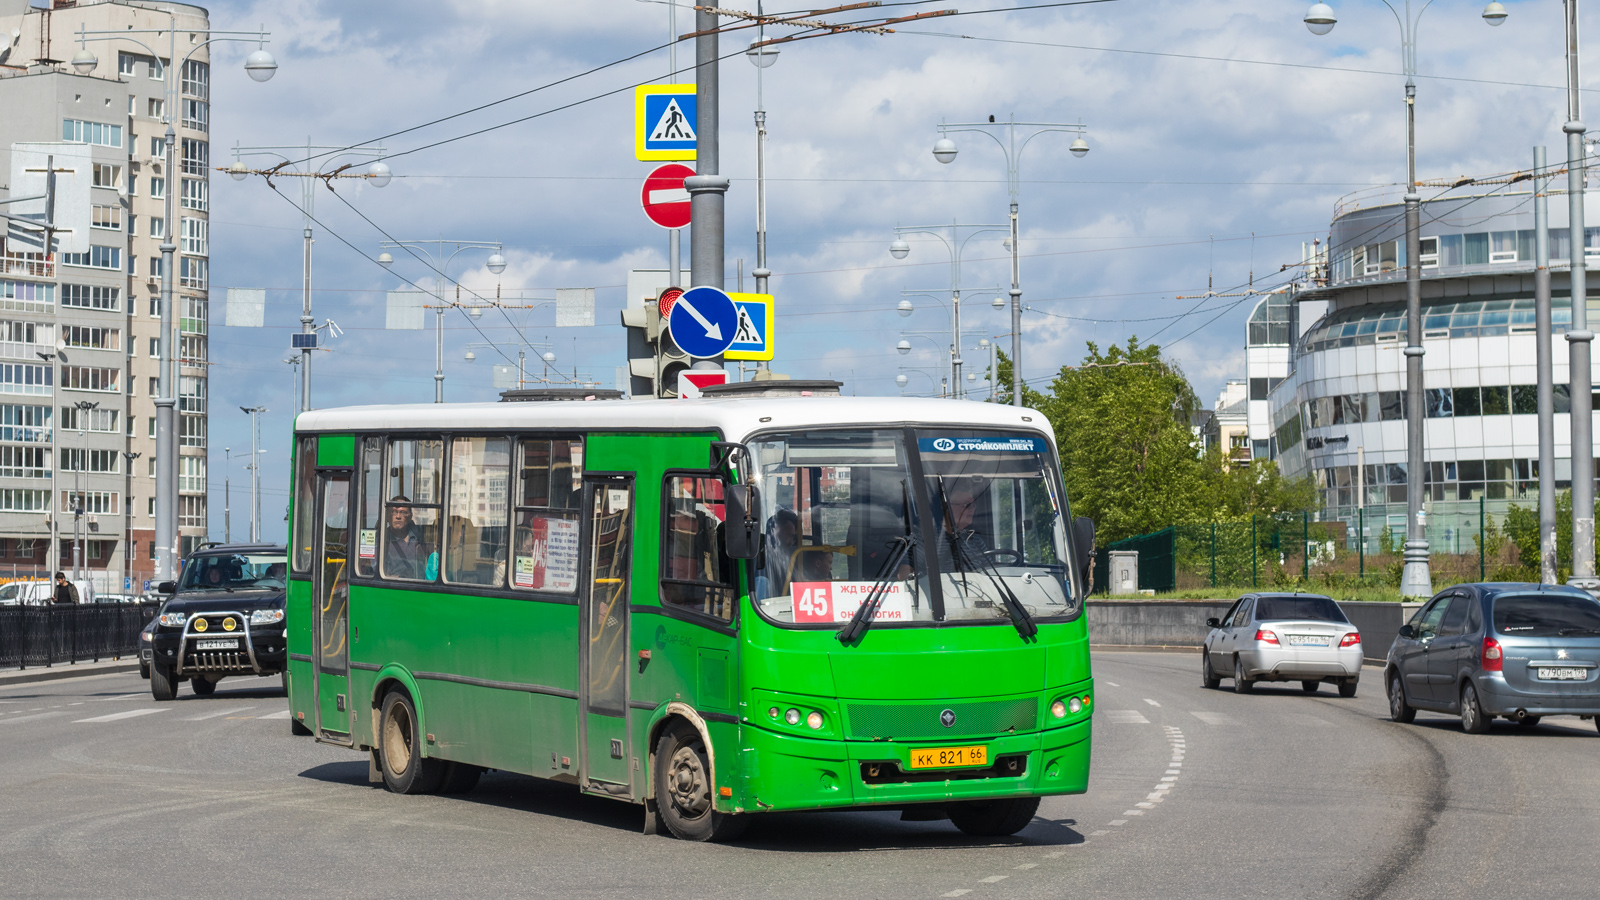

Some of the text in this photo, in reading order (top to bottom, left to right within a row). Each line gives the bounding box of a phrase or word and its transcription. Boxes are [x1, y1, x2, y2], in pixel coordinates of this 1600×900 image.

[957, 441, 1034, 451] СТРОЙКОМПЛЕКТ
[840, 585, 857, 595] ЖД
[798, 588, 828, 616] 45
[939, 750, 963, 764] 821
[970, 748, 982, 759] 66
